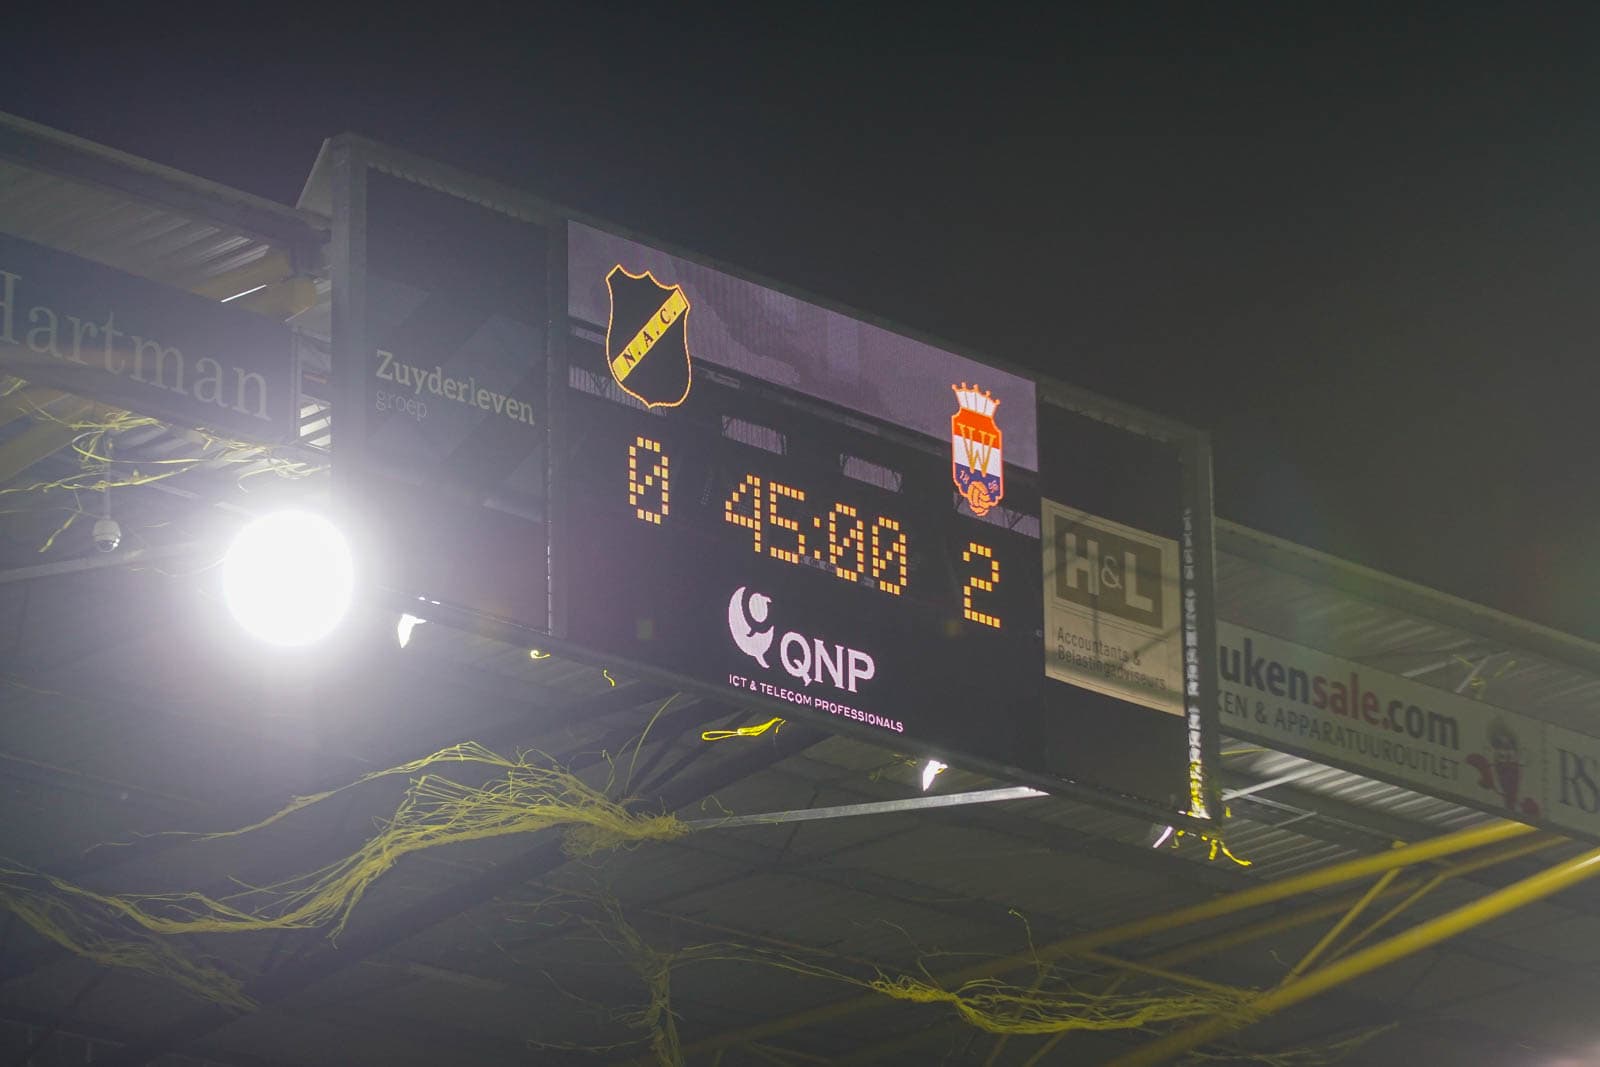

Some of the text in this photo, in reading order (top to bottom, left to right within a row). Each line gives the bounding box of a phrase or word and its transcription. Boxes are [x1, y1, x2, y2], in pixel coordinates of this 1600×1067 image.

[375, 349, 535, 425] Zuyderleven
[375, 389, 428, 421] groep
[629, 436, 669, 525] 0
[725, 474, 907, 596] 45:00
[963, 542, 1001, 628] 2
[780, 631, 876, 693] QNP
[1057, 626, 1130, 662] Accountants
[729, 673, 904, 733] ICT & TELECOM PROFESSIONALS
[1254, 701, 1269, 725] &
[1274, 708, 1459, 781] APPARATUUROUTLET
